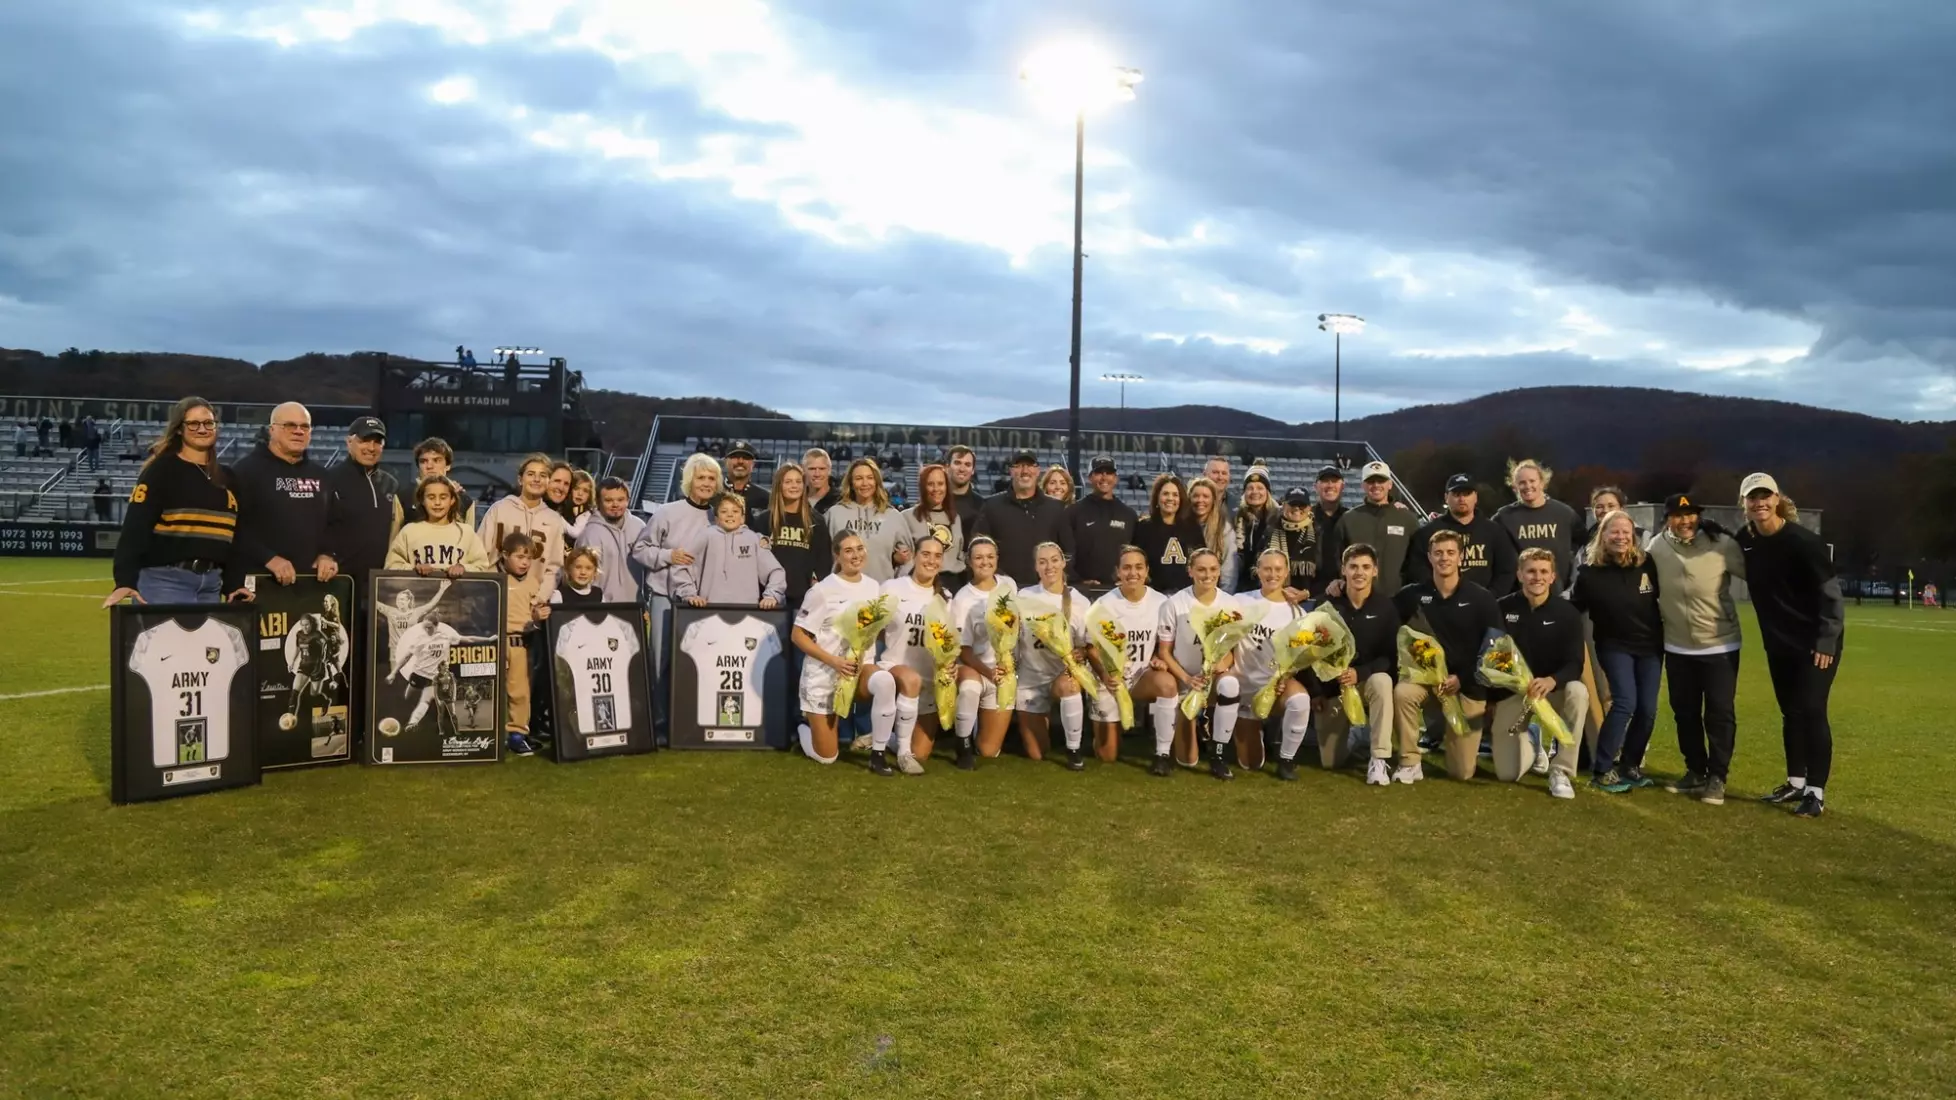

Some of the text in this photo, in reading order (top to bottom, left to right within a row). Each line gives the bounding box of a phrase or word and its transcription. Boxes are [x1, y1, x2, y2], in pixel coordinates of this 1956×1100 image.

[424, 395, 510, 406] MALEK STADIUM
[949, 428, 1041, 449] HONOR
[1080, 433, 1205, 453] OUNTRY
[276, 477, 321, 492] ARMY
[1679, 496, 1690, 507] A
[845, 519, 882, 532] ARMY
[1518, 523, 1557, 540] ARMY
[1, 529, 83, 540] 1972 1975 1993
[1, 541, 84, 551] 1973 1991 1996
[739, 545, 750, 555] W
[1161, 536, 1187, 564] A
[413, 544, 466, 566] ARMY
[1639, 572, 1653, 591] A
[1127, 629, 1152, 642] RMY
[449, 645, 496, 664] BRIGID
[1126, 643, 1145, 662] 21
[587, 658, 613, 671] ARMY
[716, 655, 748, 669] ARMY
[171, 671, 210, 690] ARMY
[591, 672, 612, 695] 30
[720, 670, 743, 691] 28
[179, 690, 203, 717] 31
